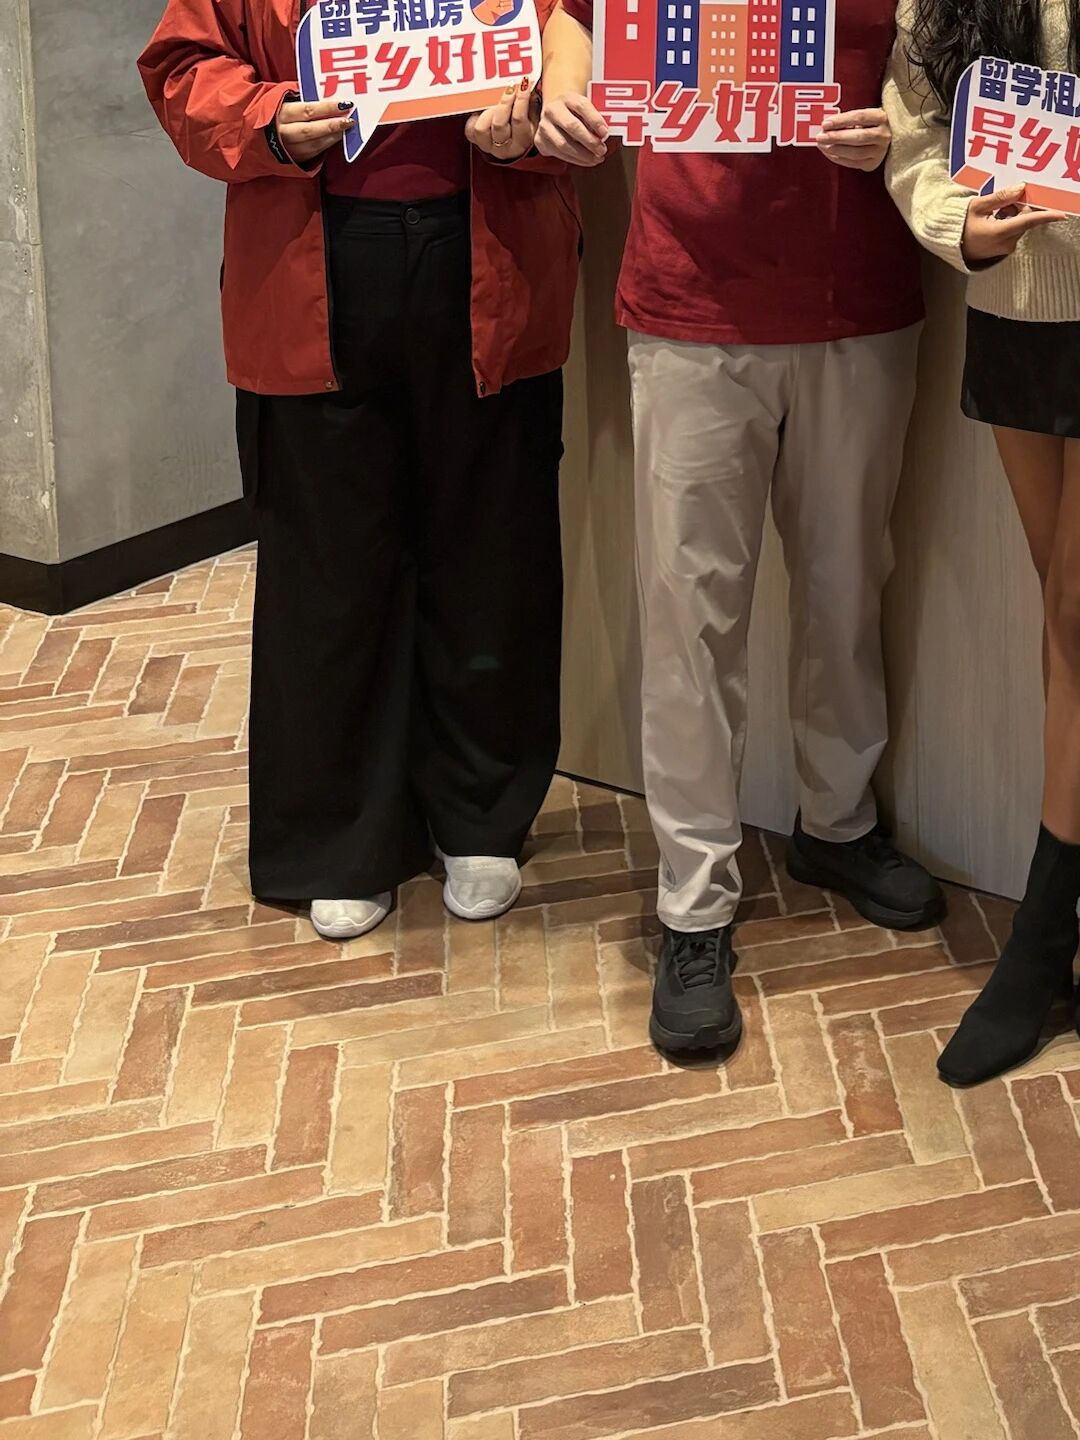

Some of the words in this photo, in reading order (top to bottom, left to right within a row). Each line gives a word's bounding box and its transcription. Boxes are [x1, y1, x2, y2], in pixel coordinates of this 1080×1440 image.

[319, 26, 533, 98] 异乡好居
[590, 81, 840, 143] 异乡好居
